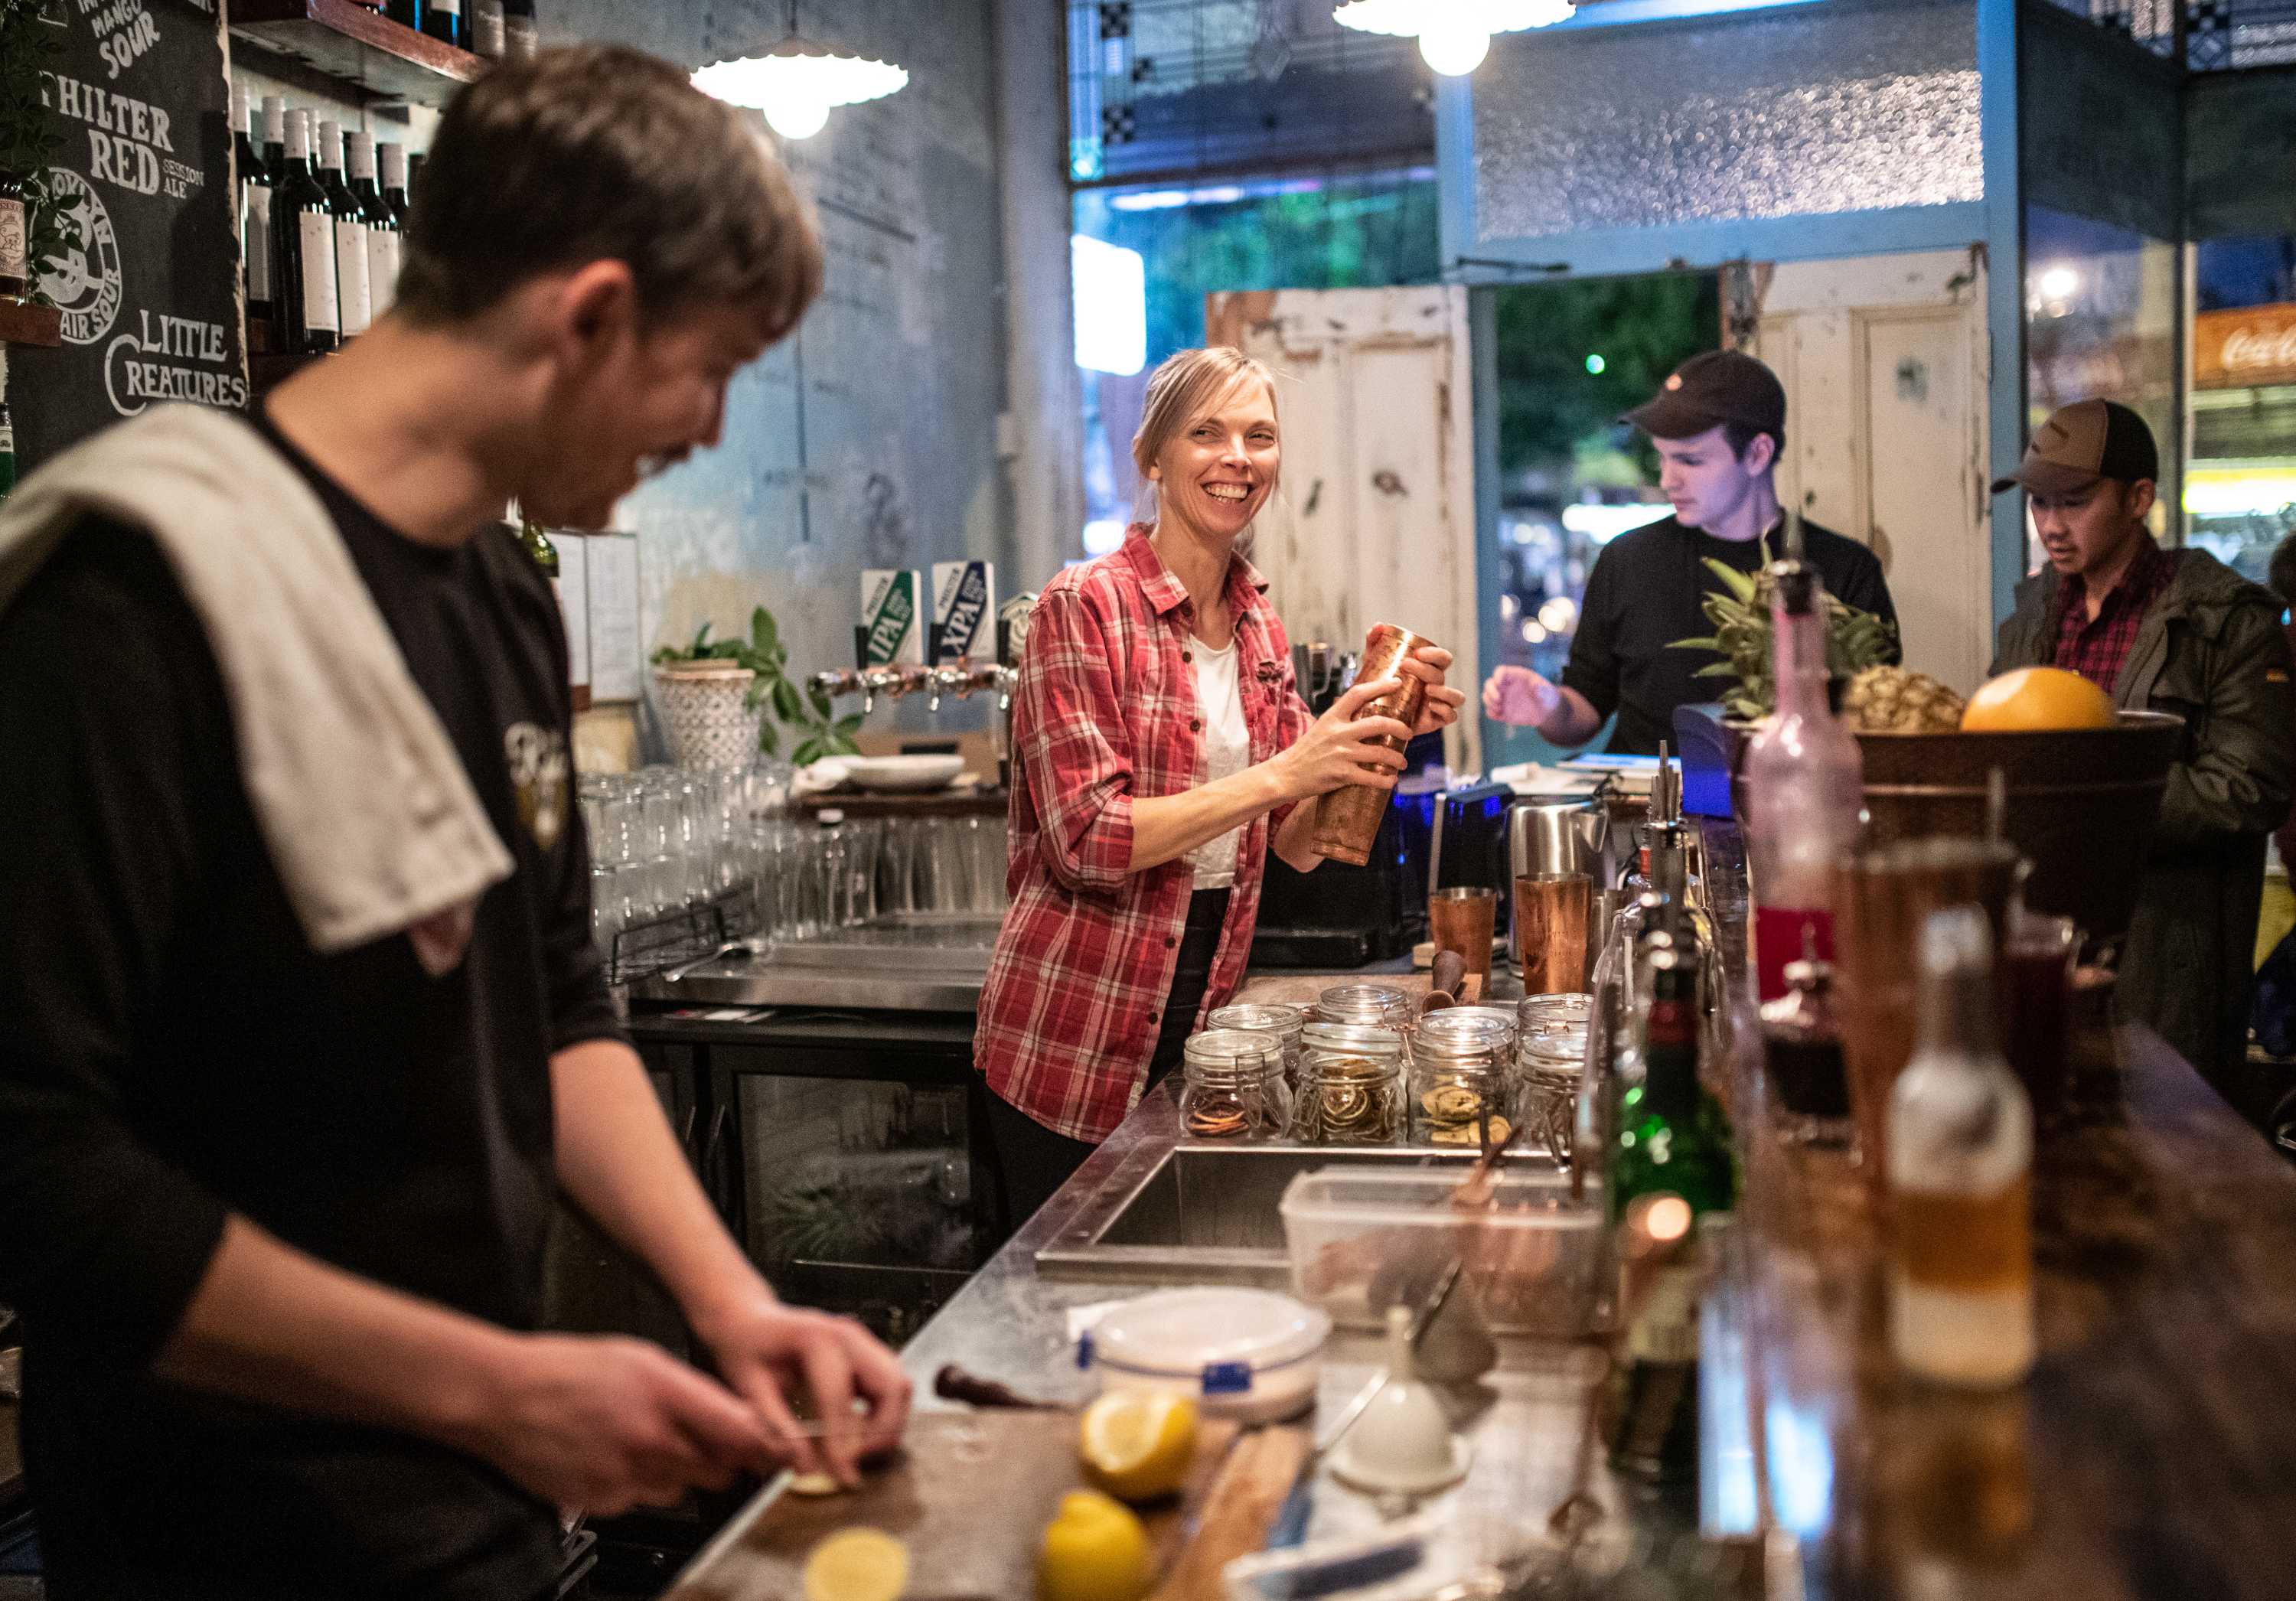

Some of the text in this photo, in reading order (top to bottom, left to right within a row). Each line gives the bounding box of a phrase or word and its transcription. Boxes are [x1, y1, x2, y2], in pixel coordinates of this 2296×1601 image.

[91, 0, 142, 38] MANGO
[99, 11, 161, 79] SOUR
[88, 129, 160, 195] RED
[162, 158, 204, 187] SESSION
[163, 176, 187, 199] ALE
[60, 268, 119, 339] AIR SOUR
[139, 309, 227, 362] LITTLE
[104, 334, 246, 416] CREATURES
[867, 616, 904, 661] IPA
[941, 601, 980, 654] XPA
